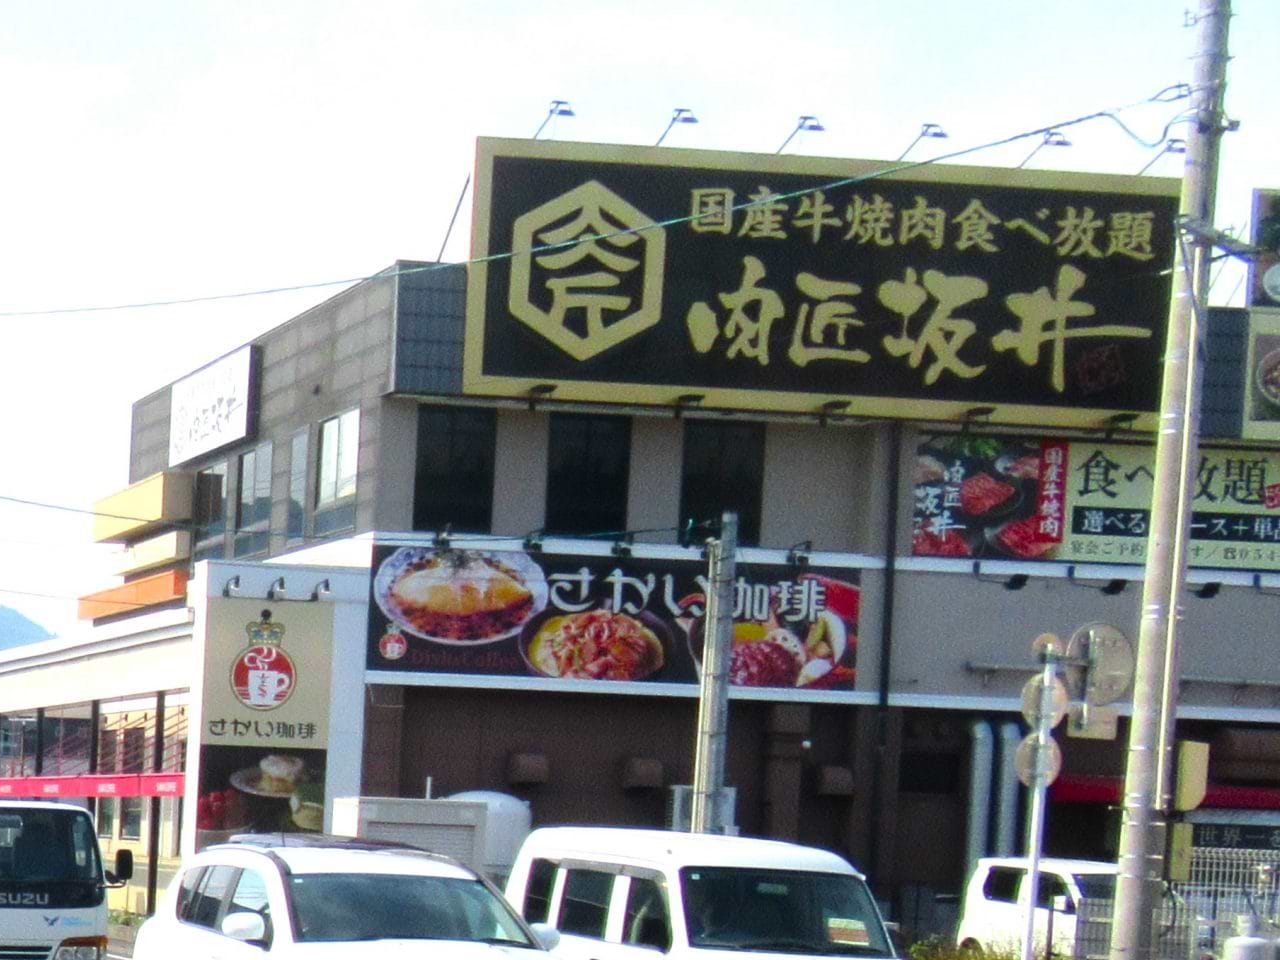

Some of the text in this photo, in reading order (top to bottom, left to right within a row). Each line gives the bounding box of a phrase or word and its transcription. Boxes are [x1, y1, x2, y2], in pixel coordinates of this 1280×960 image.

[688, 185, 1157, 262] 国産牛焼肉食べ放題
[686, 256, 1152, 394] 肉匠坂井
[1039, 447, 1063, 538] 国産牛焼肉
[208, 718, 318, 739] さかい珈琲
